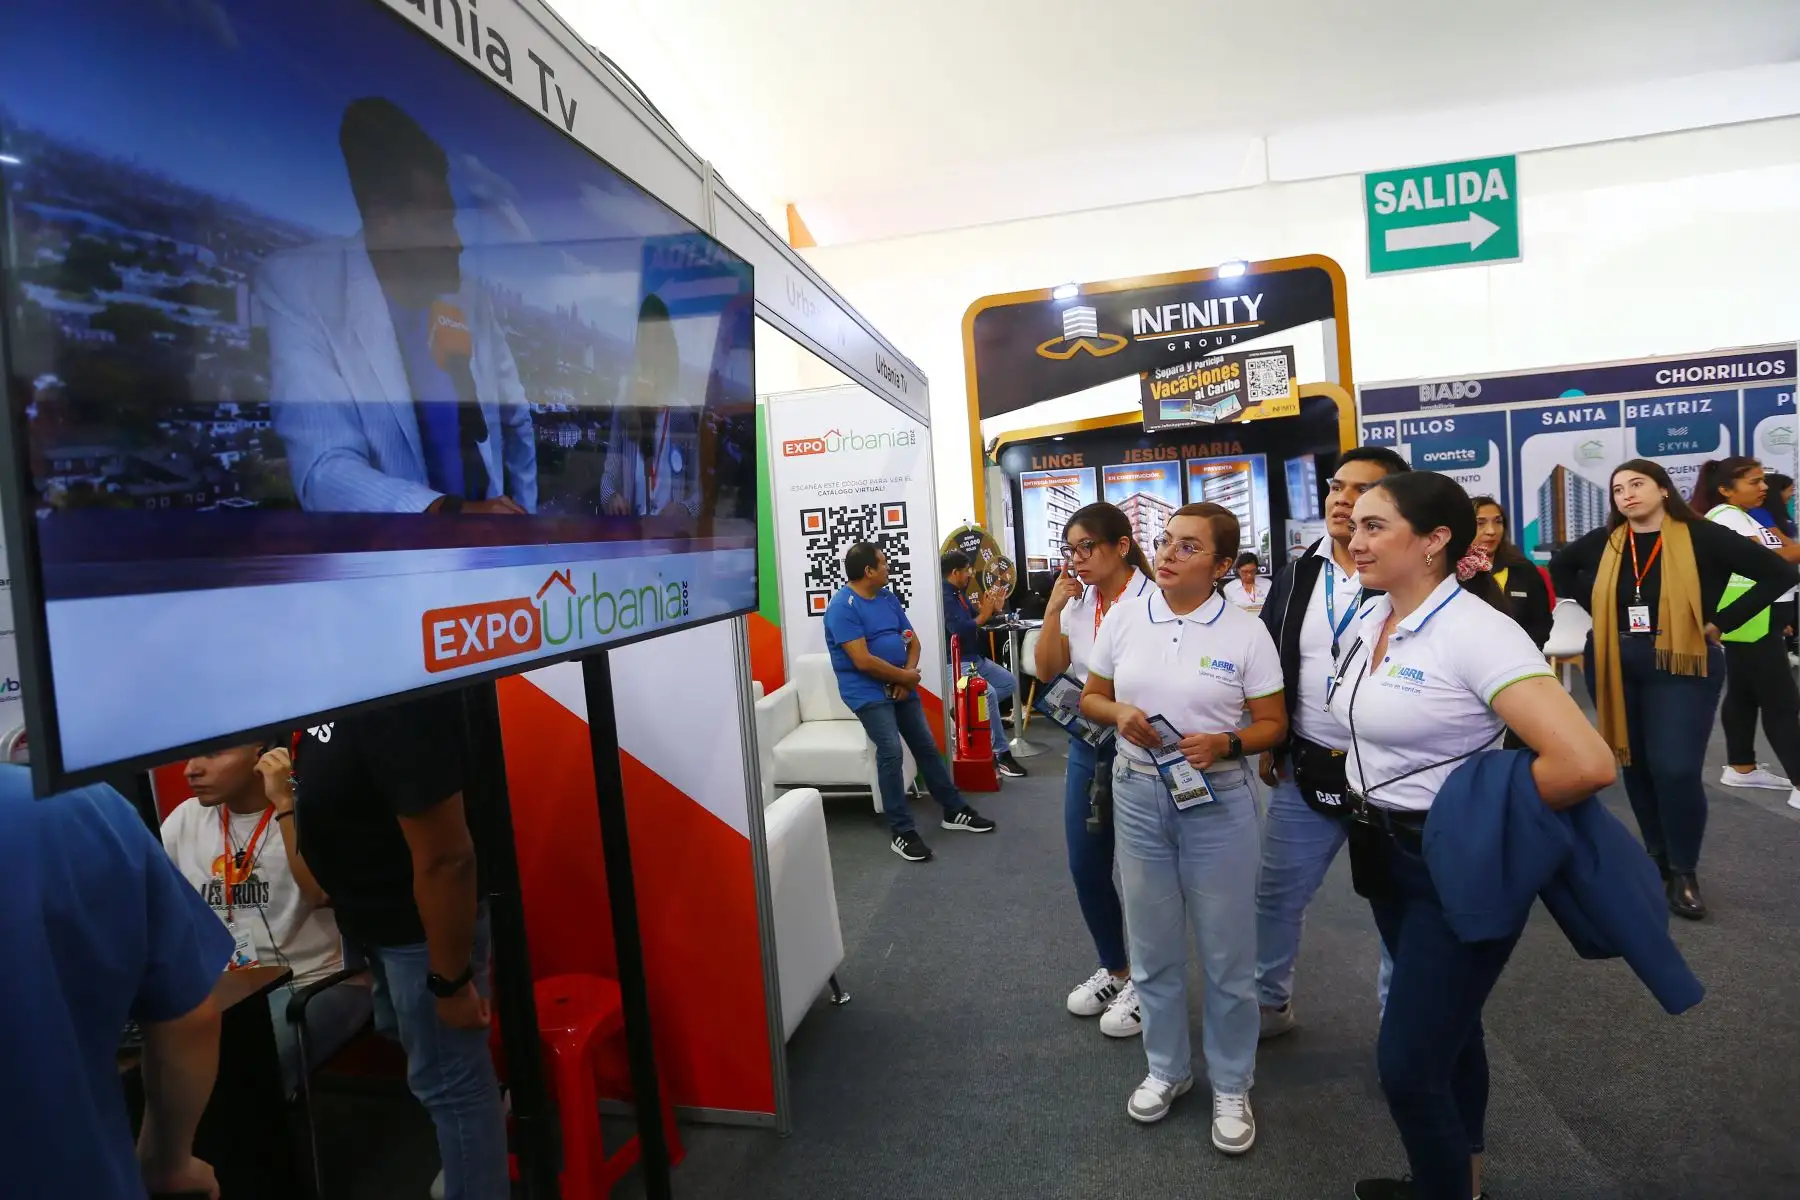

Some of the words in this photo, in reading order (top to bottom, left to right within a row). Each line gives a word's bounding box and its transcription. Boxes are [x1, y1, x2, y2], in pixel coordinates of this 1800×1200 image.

[527, 48, 577, 132] Tv
[1374, 168, 1509, 215] SALIDA
[1132, 293, 1264, 335] INFINITY
[1168, 335, 1238, 352] GROUP
[876, 351, 900, 389] Urbania
[899, 374, 908, 394] Tv
[1155, 363, 1184, 379] Separa
[1186, 361, 1192, 372] y
[1194, 355, 1224, 369] Participa
[1655, 359, 1786, 385] CHORRILLOS
[1151, 362, 1240, 400] Vacaciones
[1194, 389, 1205, 400] al
[1208, 378, 1240, 396] Caribe
[1418, 381, 1482, 402] BIABO
[1542, 408, 1606, 426] SANTA
[1626, 399, 1713, 419] BEATRIZ
[785, 441, 823, 454] EXPO
[826, 428, 910, 452] Urbania
[1032, 453, 1084, 470] LINCE
[1122, 444, 1178, 464] JESÚS
[1423, 449, 1476, 462] avantte
[433, 609, 533, 661] EXPO
[543, 572, 681, 645] Urbania
[1211, 659, 1236, 673] ABRIL
[1316, 790, 1341, 805] CAT
